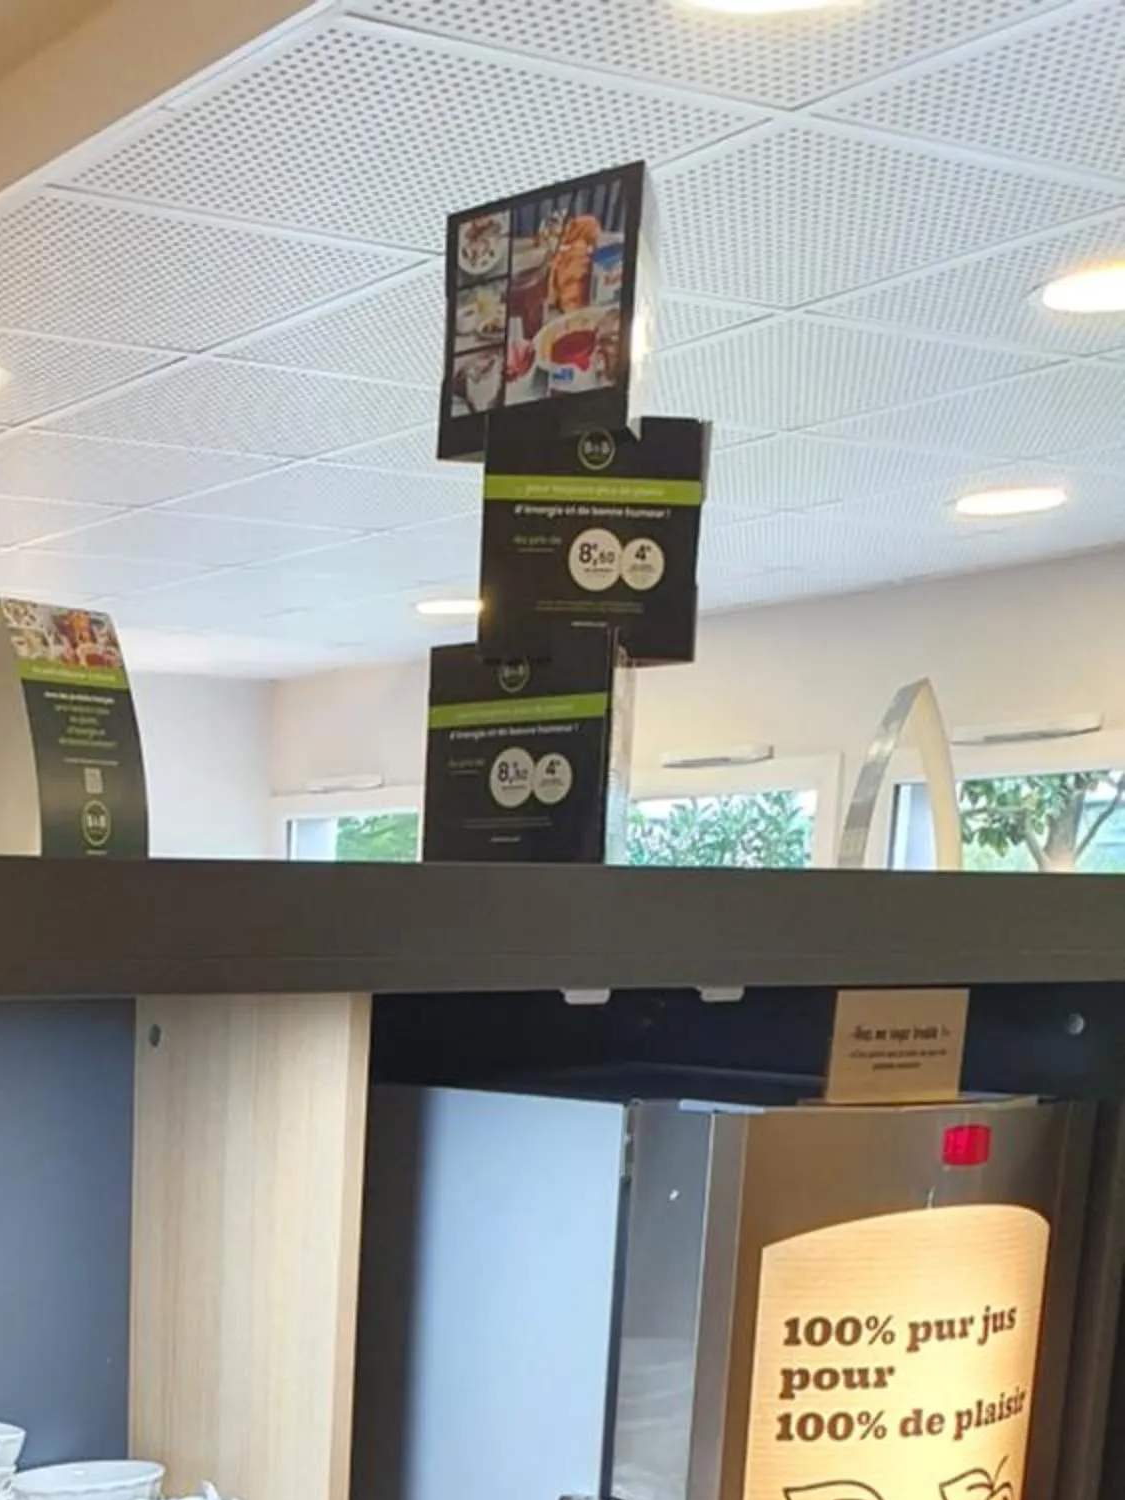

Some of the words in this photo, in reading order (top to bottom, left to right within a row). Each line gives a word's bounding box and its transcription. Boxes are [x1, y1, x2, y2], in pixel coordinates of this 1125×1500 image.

[783, 1315, 896, 1347] 100%
[906, 1315, 975, 1353] pur
[977, 1305, 1017, 1346] jus
[778, 1365, 896, 1400] pour
[775, 1410, 888, 1442] 100%
[899, 1408, 946, 1437] de
[952, 1386, 1027, 1442] plaisir
